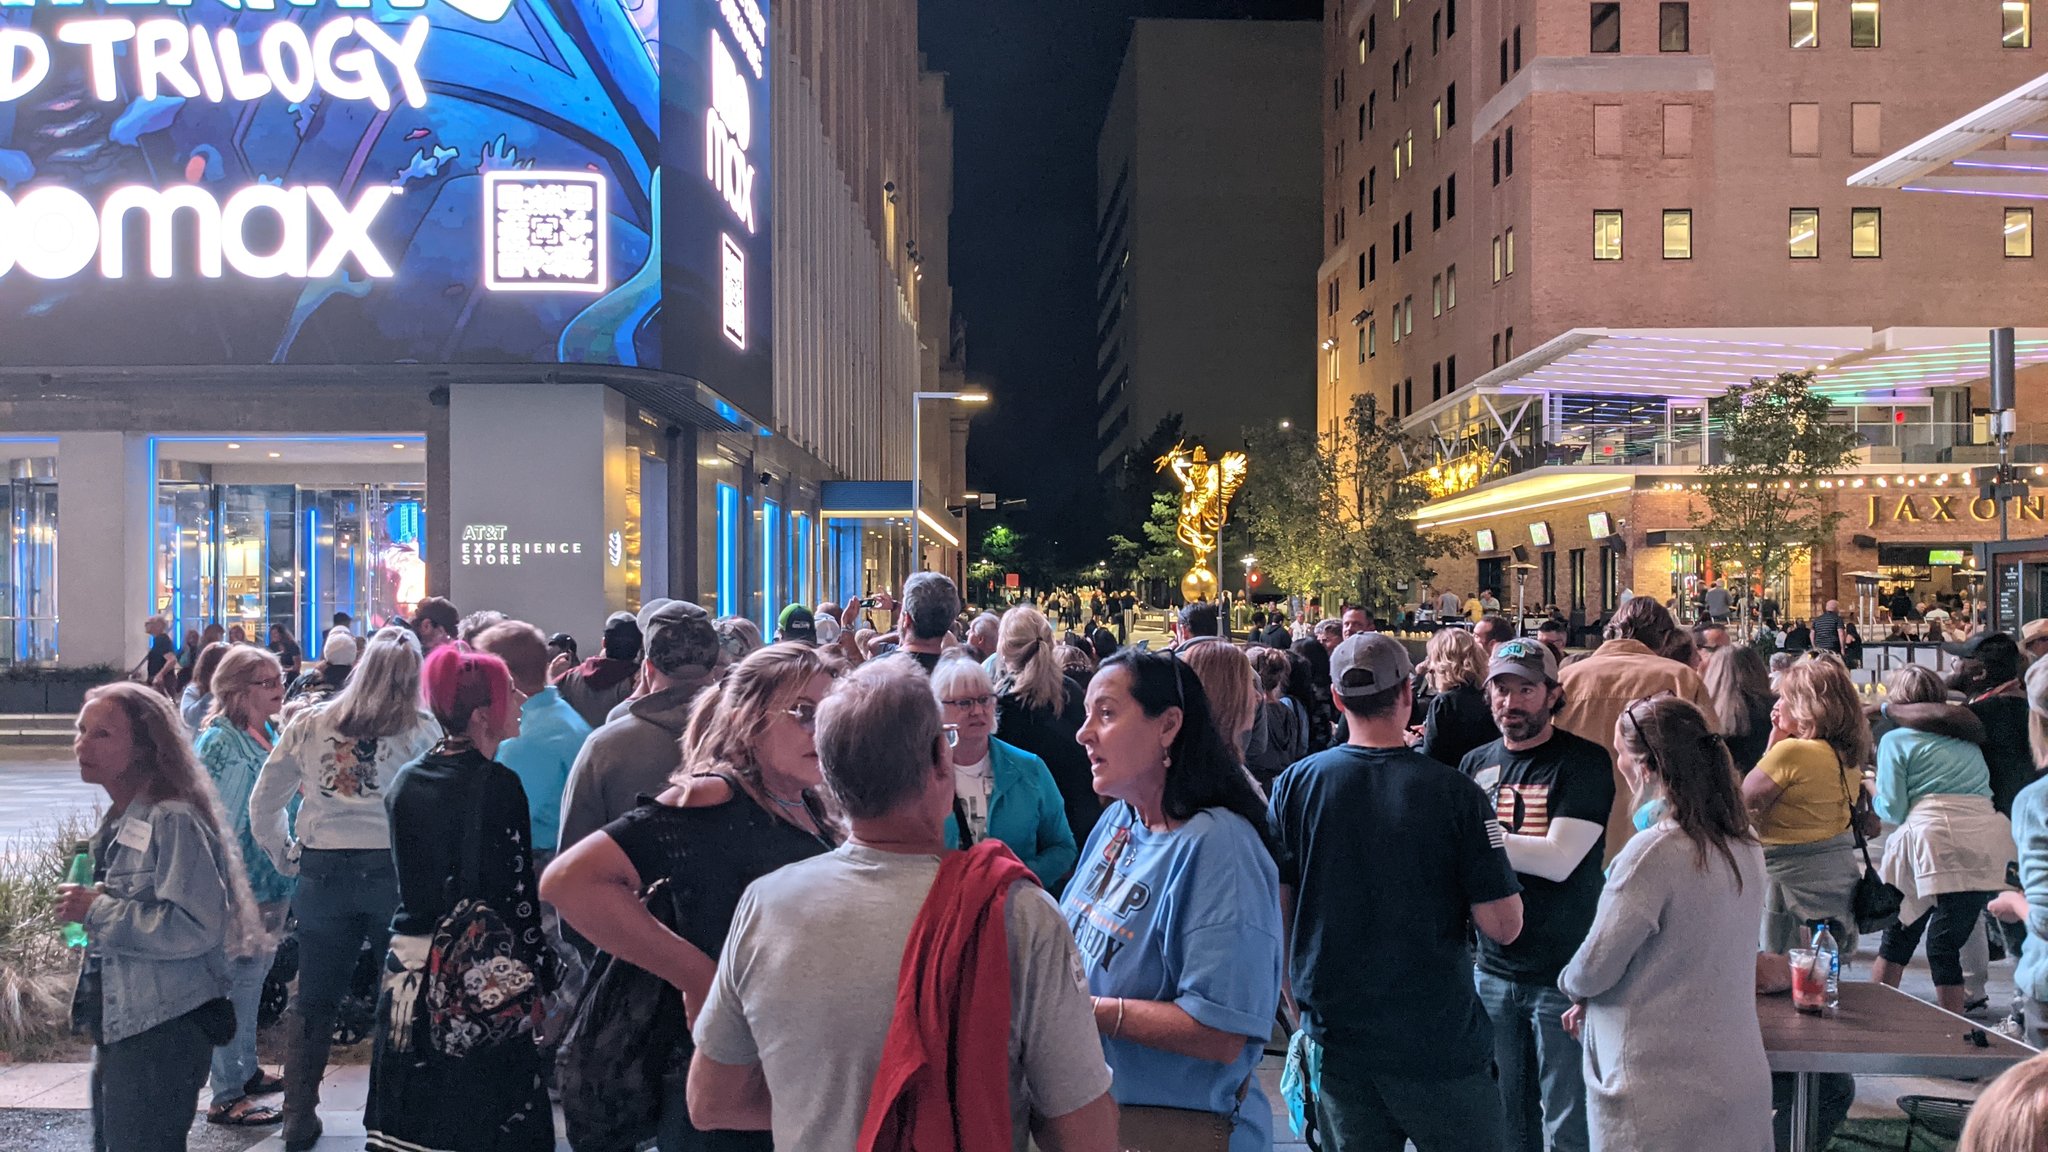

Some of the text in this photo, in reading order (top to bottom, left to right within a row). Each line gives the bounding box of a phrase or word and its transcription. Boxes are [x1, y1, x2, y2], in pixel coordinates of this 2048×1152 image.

[58, 15, 430, 110] TRILOGY
[1867, 494, 2045, 528] JAXON
[462, 525, 508, 541] AT&T
[462, 543, 582, 553] EXPERIENCE
[462, 554, 521, 565] STORE
